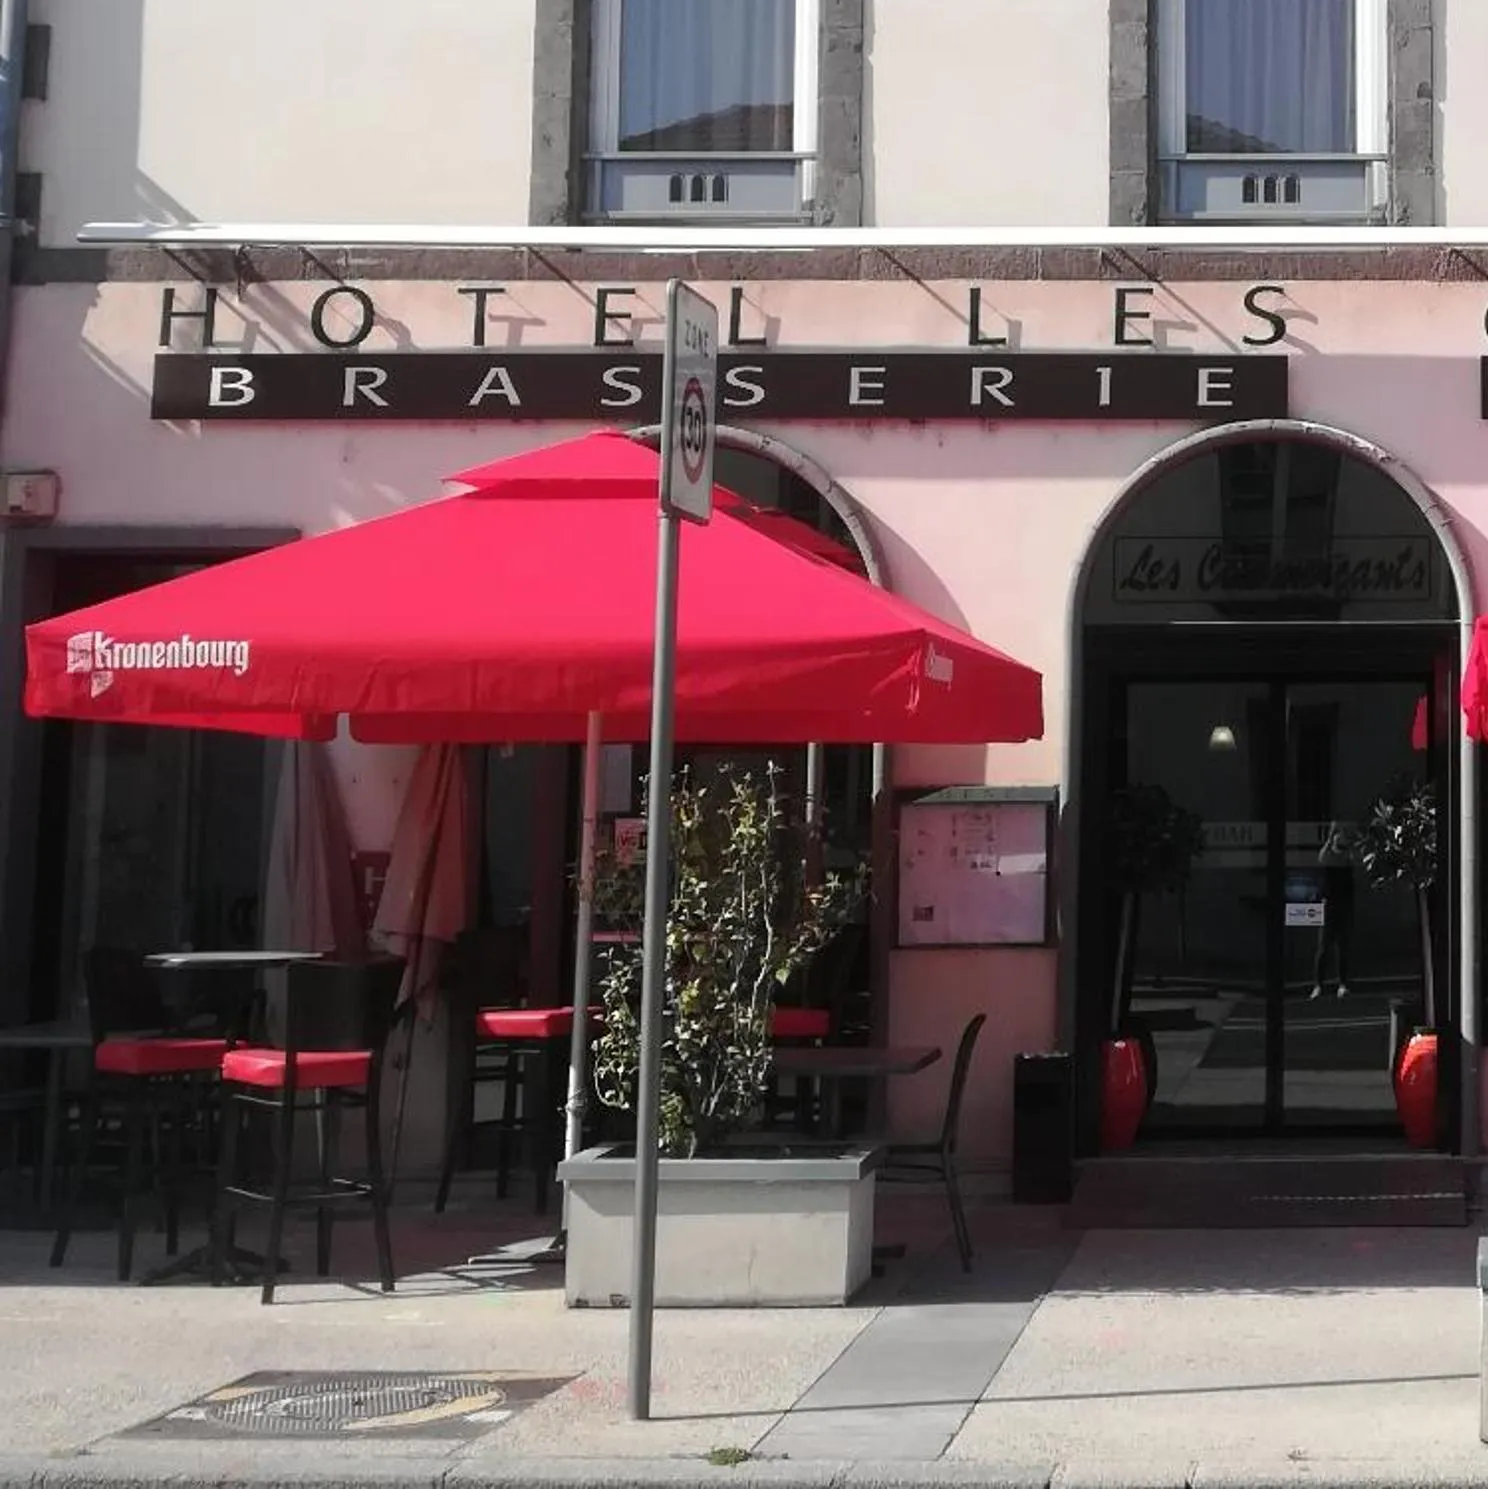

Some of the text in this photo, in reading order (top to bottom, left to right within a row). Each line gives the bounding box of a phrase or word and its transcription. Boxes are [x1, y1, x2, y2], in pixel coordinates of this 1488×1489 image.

[159, 286, 767, 349] HOTEL
[968, 286, 1288, 348] LES
[684, 319, 710, 358] ZONE
[208, 365, 1234, 408] BRASSERIE
[685, 406, 702, 453] 30
[94, 631, 250, 677] Kronenbourg
